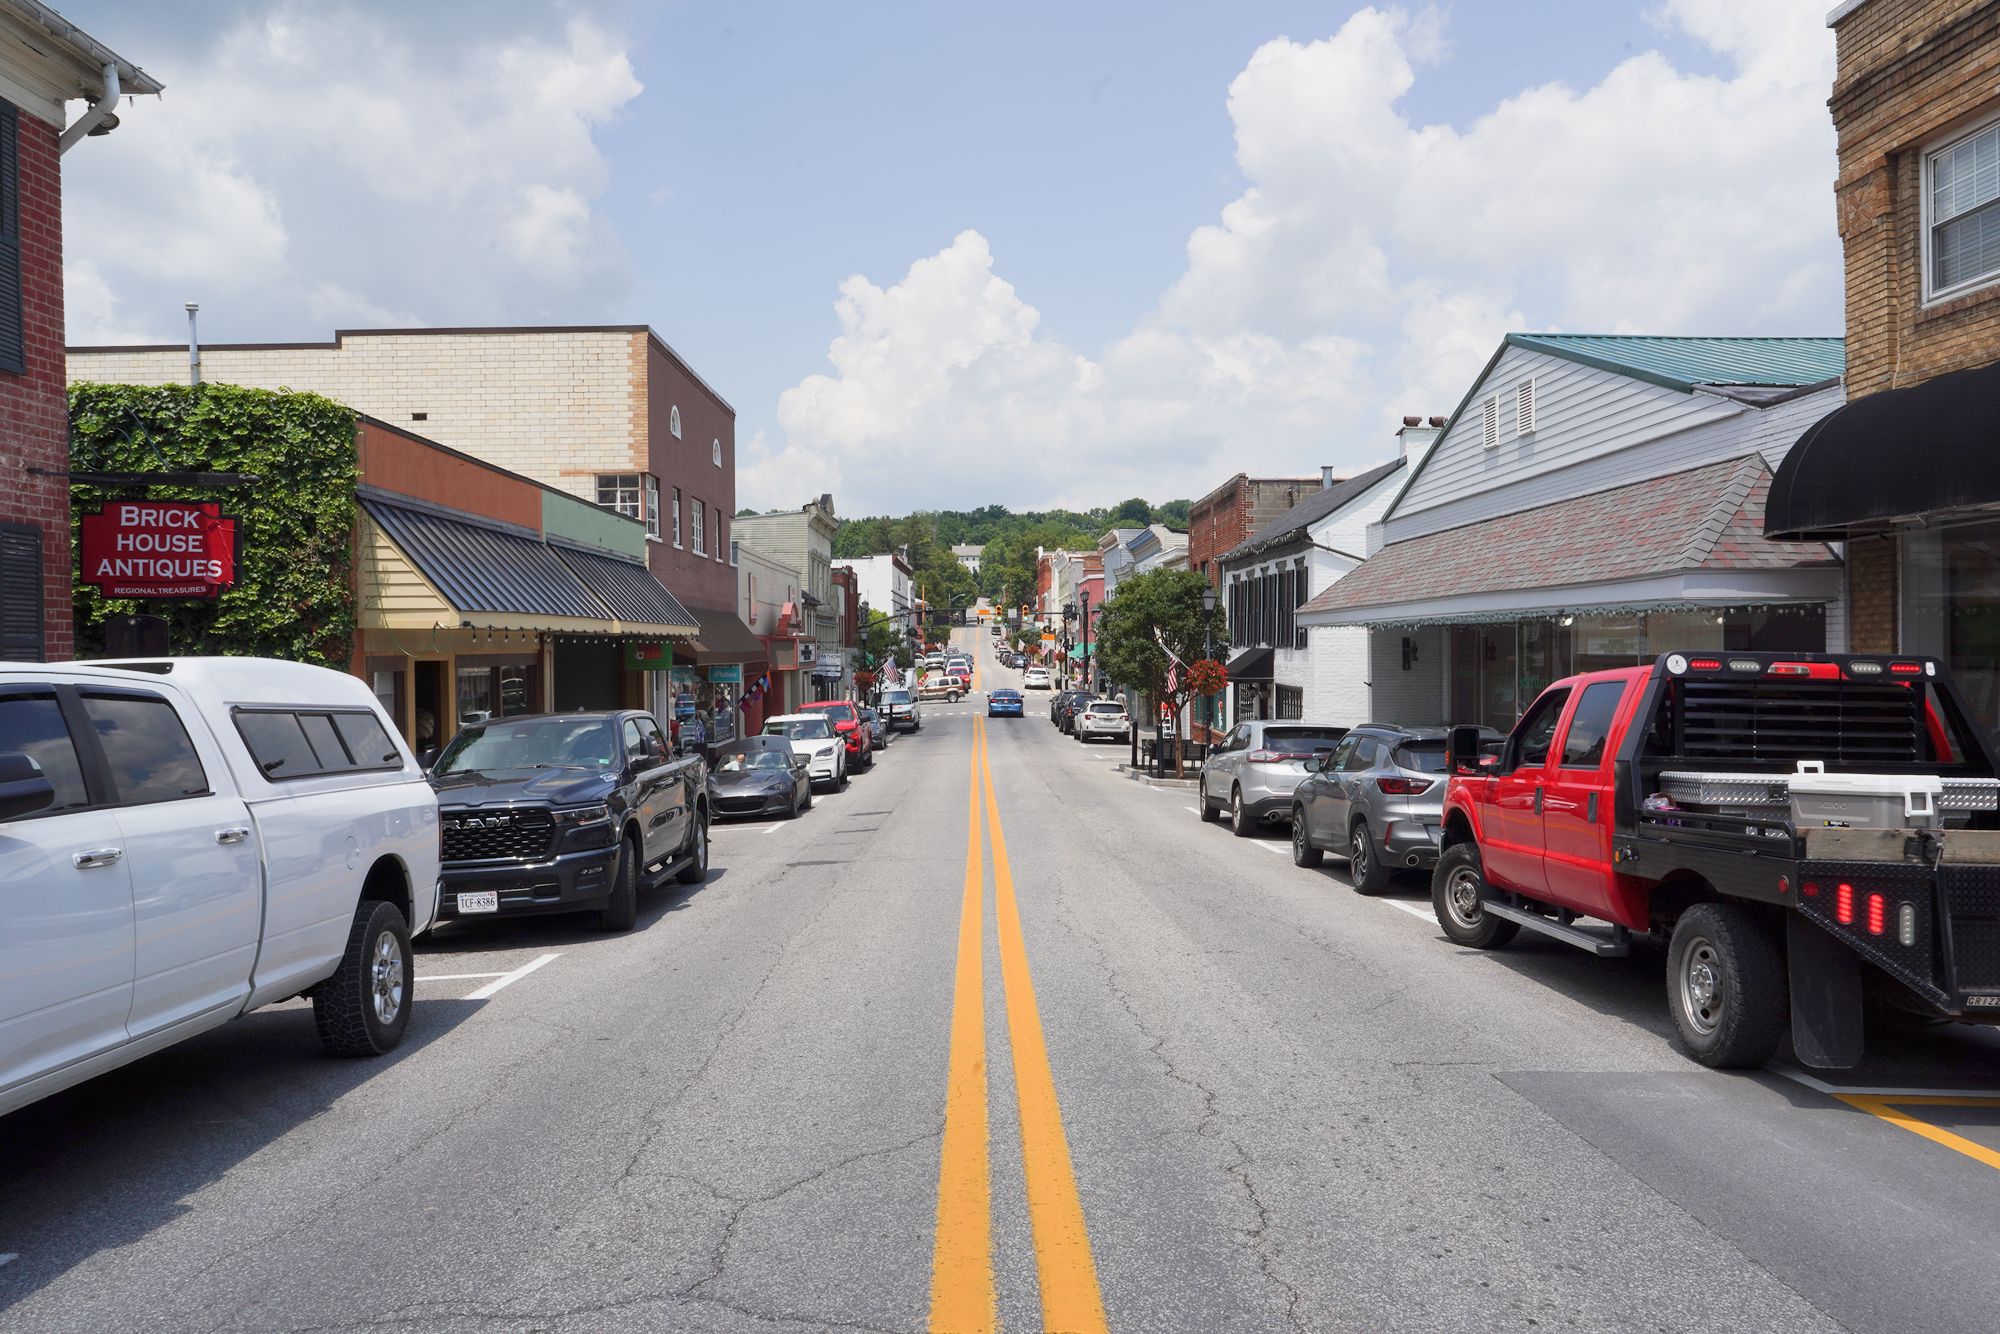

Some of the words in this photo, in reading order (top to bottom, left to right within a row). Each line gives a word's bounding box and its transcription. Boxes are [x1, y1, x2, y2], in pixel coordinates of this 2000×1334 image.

[120, 505, 201, 529] BRICK
[117, 533, 203, 552] HOUSE
[96, 558, 223, 579] ANTIQUES
[114, 587, 157, 595] REGIONAL
[158, 586, 207, 595] TREASURES
[441, 816, 510, 830] RAM
[461, 897, 496, 909] TCF-8386
